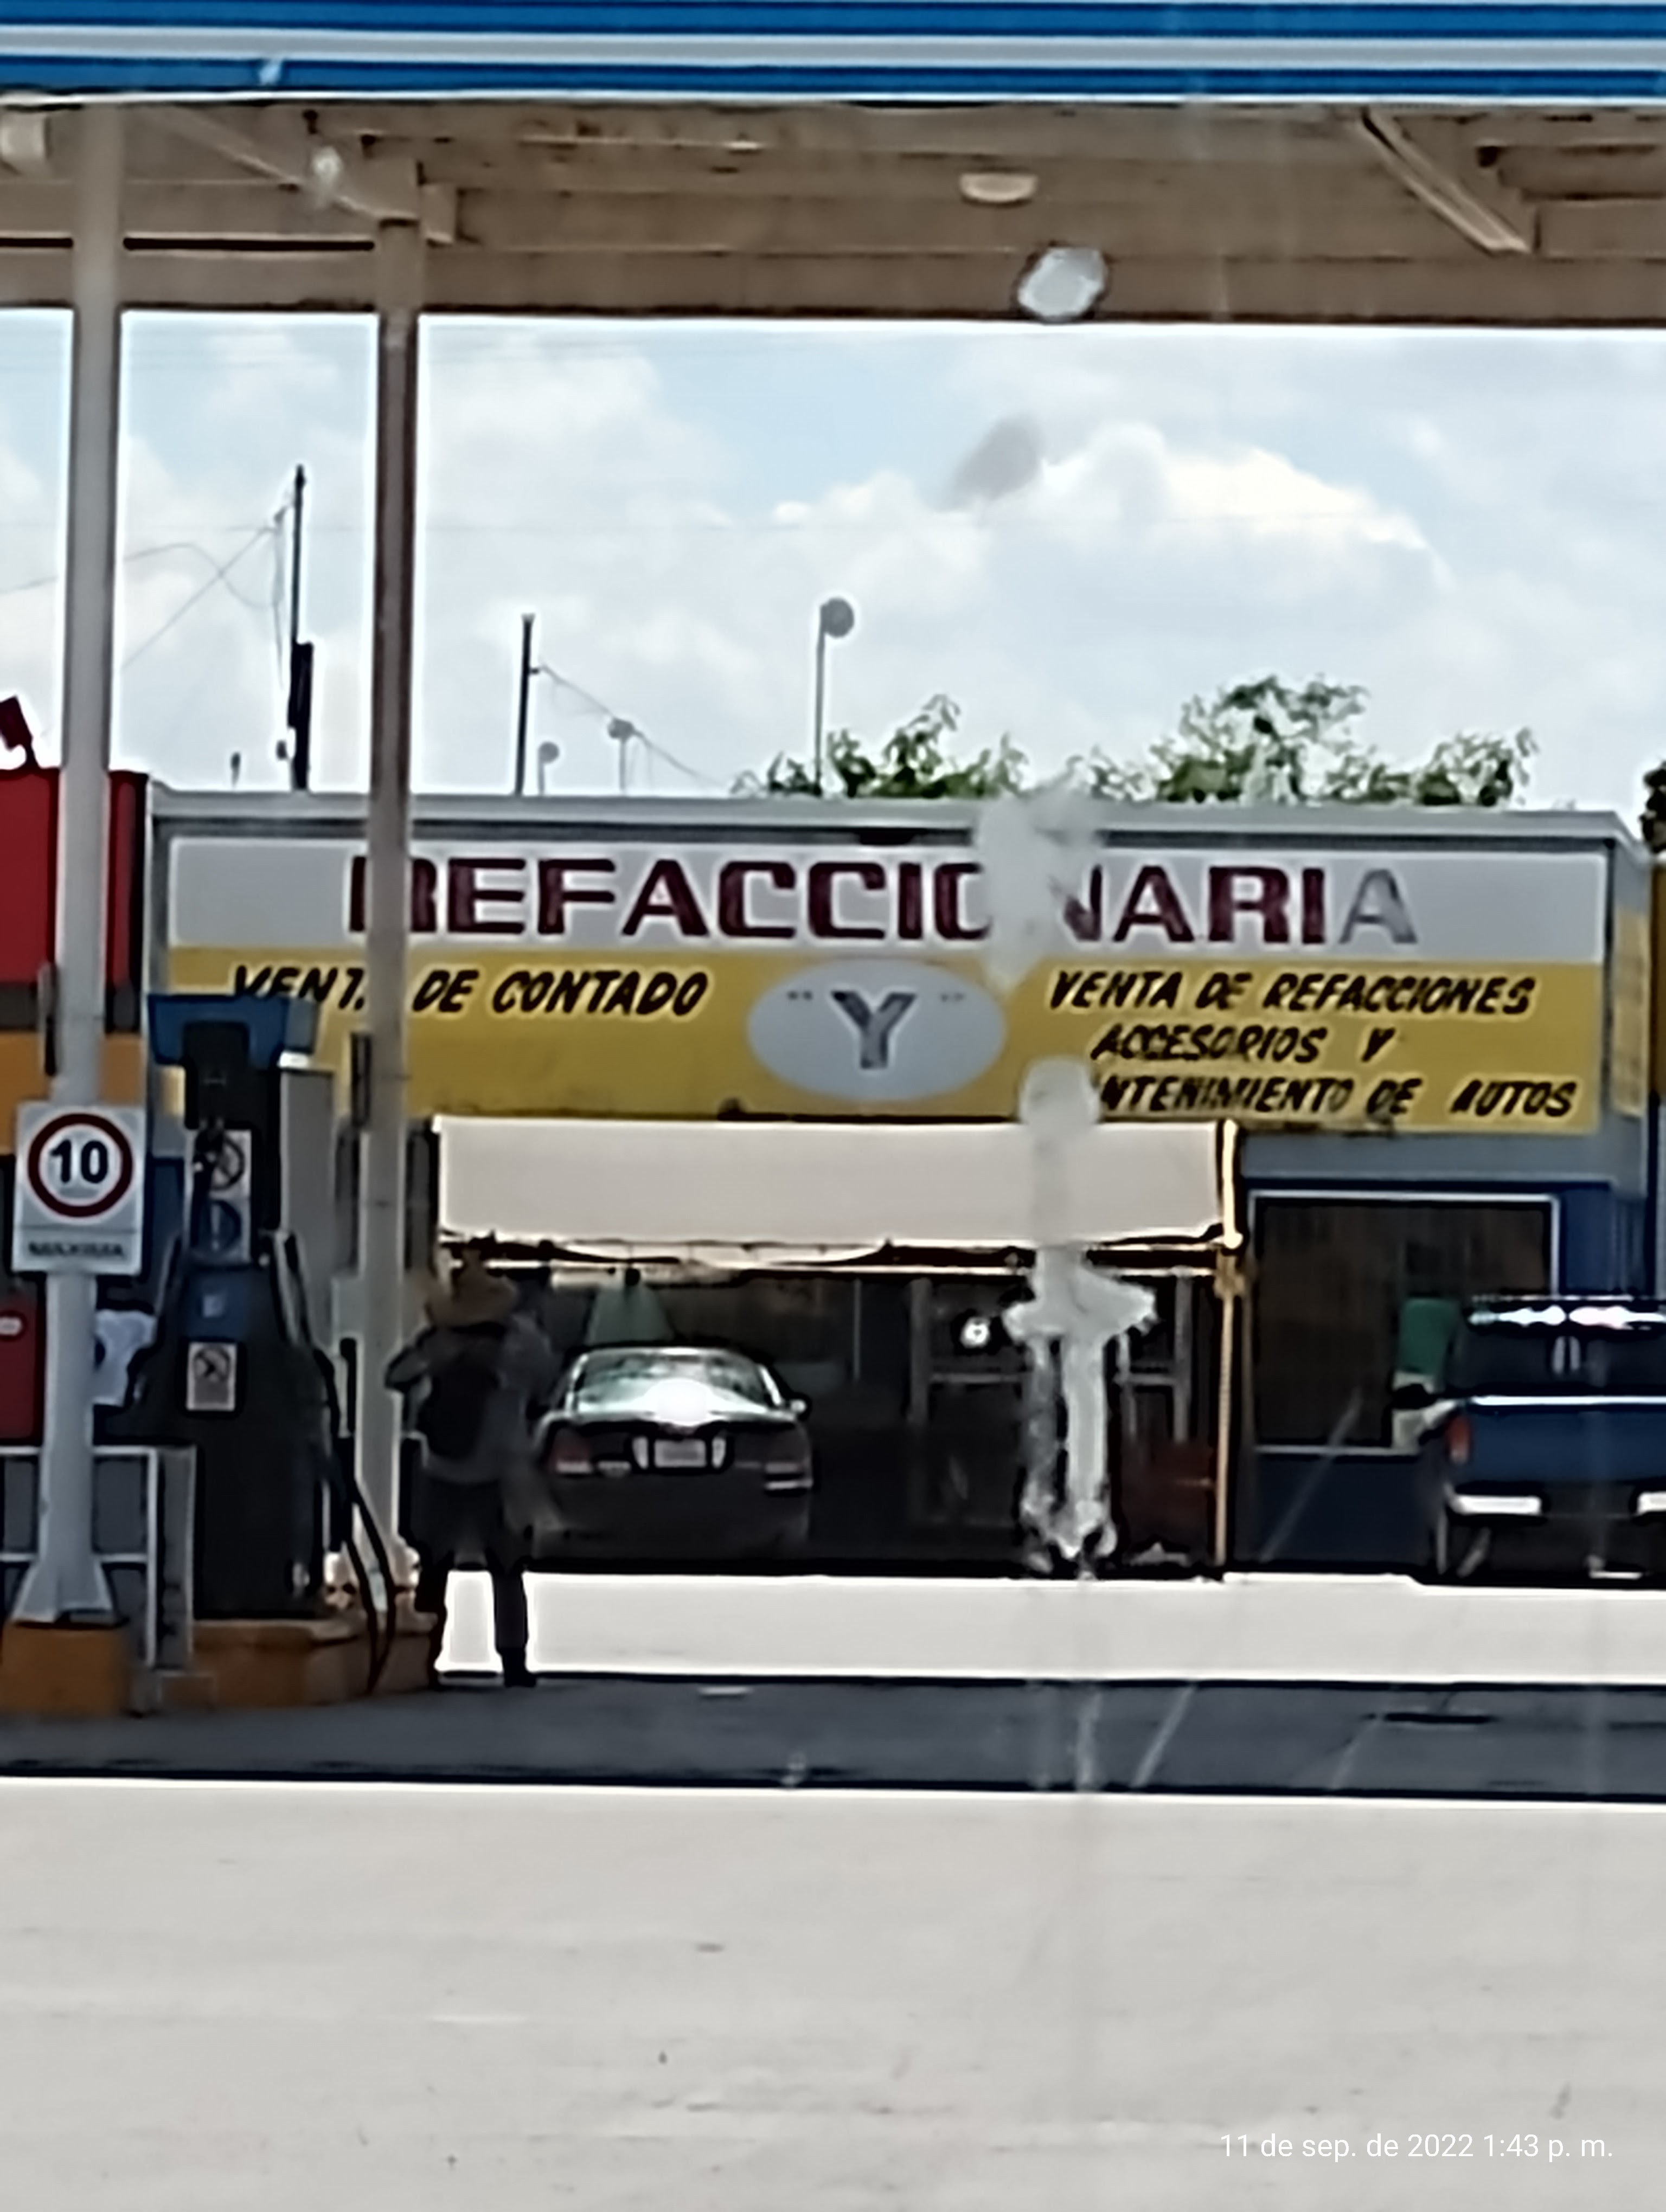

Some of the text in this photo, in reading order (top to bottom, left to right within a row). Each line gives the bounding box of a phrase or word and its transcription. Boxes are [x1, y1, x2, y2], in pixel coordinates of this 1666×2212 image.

[235, 965, 708, 1015] VENT DE CONTADO
[1050, 970, 1535, 1014] VENTA DE REFACCIONES
[1090, 1024, 1396, 1063] ACCESORIOS Y
[1366, 1078, 1423, 1116] DE
[1450, 1079, 1577, 1117] AUTOS
[50, 1140, 108, 1184] 10
